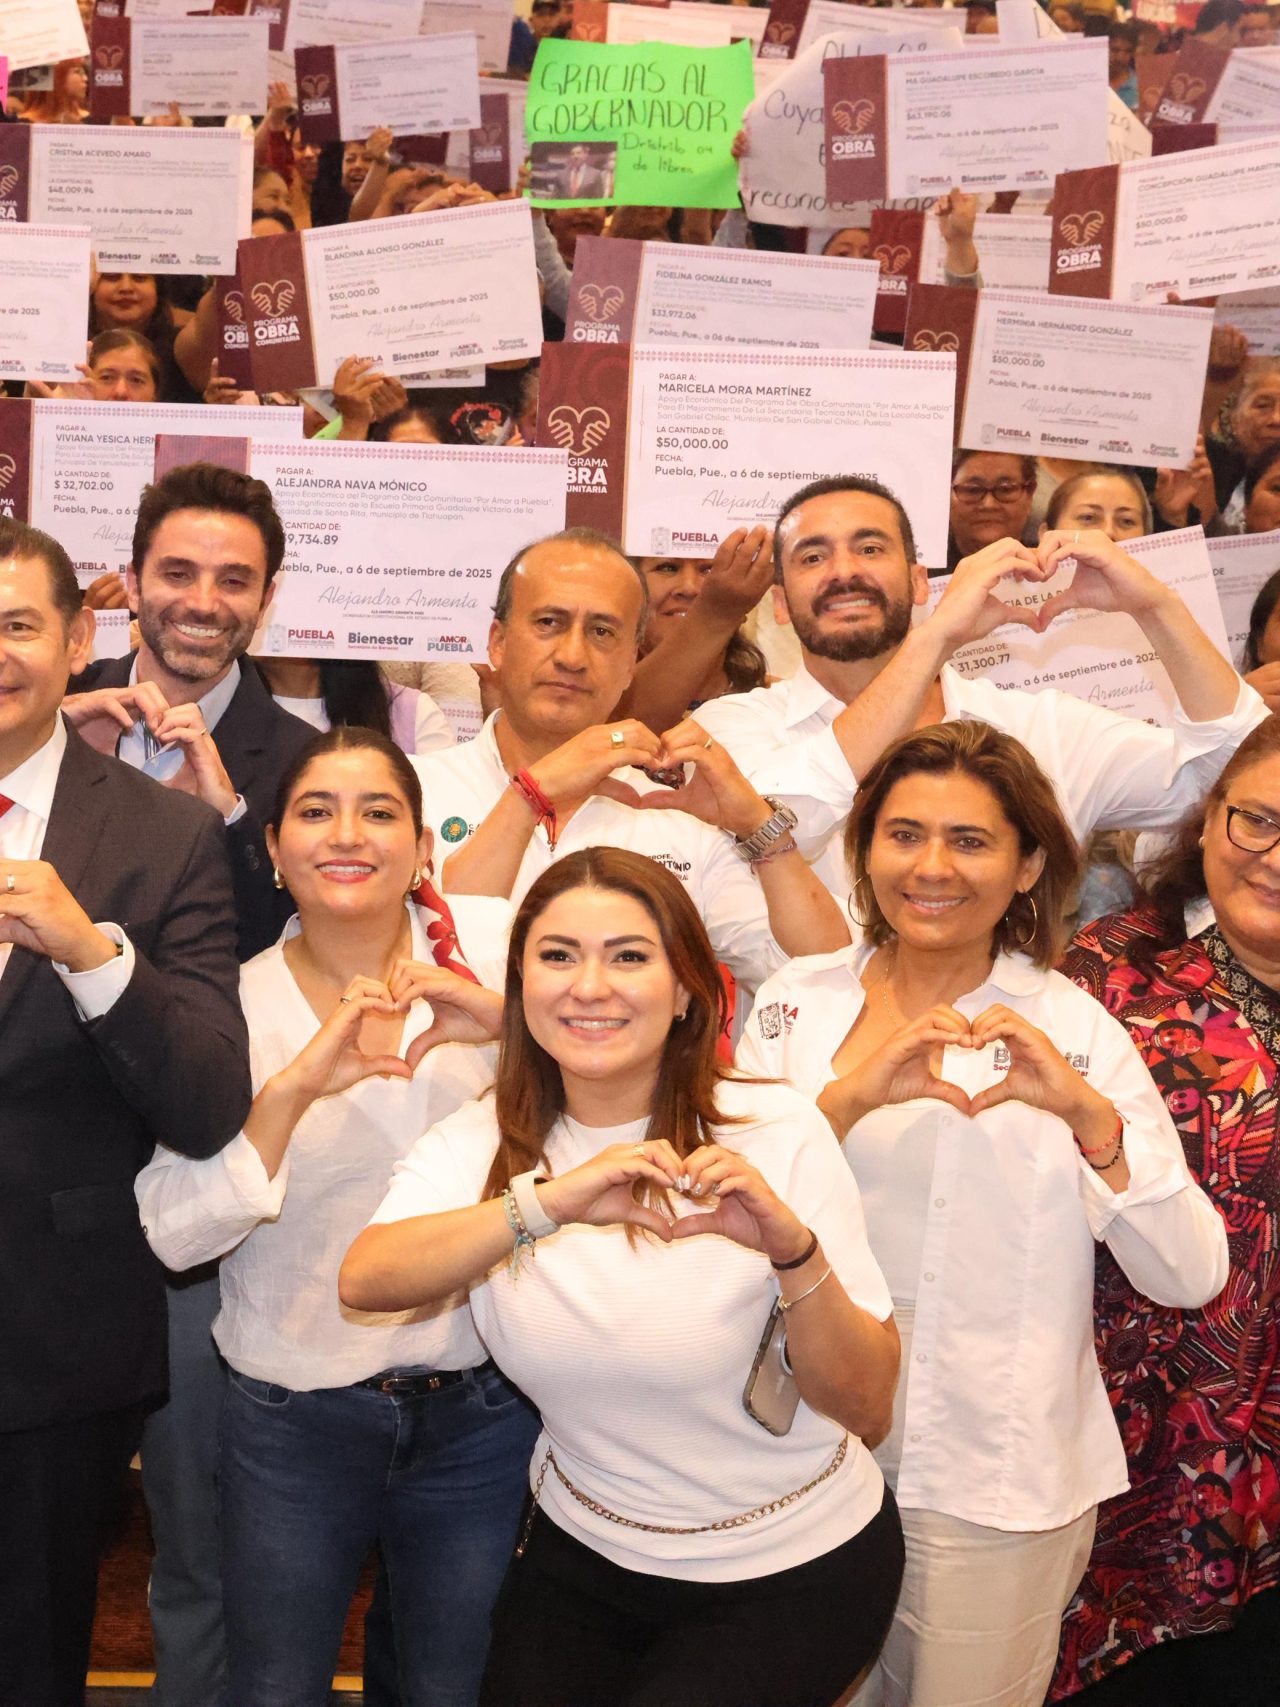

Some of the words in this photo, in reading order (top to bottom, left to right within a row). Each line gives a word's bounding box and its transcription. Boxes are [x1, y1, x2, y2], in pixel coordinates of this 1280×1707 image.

[541, 61, 666, 96] GRACIAS
[682, 63, 716, 97] AL
[324, 250, 364, 261] BLANDINA
[366, 244, 400, 255] ALONSO
[401, 238, 444, 250] GONZÁLEZ
[656, 270, 692, 280] FIDELINA
[694, 273, 739, 284] GONZÁLEZ
[741, 278, 771, 287] RAMOS
[328, 286, 379, 301] $50,000.00
[652, 308, 696, 319] $33,972.06
[253, 315, 298, 327] PROGRAMA
[574, 320, 620, 332] PROGRAMA
[997, 317, 1035, 326] HERMINIA
[1038, 321, 1087, 332] HERNÁNDEZ
[1089, 326, 1133, 336] GONZÁLEZ
[254, 323, 299, 339] OBRA
[573, 329, 619, 343] OBRA
[392, 350, 439, 361] Bienestar
[992, 355, 1045, 367] $50,000.00
[659, 383, 715, 393] MARICELA
[718, 385, 752, 394] MORA
[756, 385, 811, 396] MARTÍNEZ
[56, 434, 93, 442] VIVIANA
[96, 435, 130, 443] YESICA
[996, 428, 1030, 437] PUEBLA
[1040, 433, 1089, 445] Bienestar
[656, 436, 728, 449] $50,000.00
[568, 458, 608, 467] GRAMA
[566, 466, 608, 485] BRA
[54, 480, 60, 489] $
[63, 480, 113, 490] 32,702.00
[275, 478, 341, 488] ALEJANDRA
[344, 480, 376, 489] NAVA
[379, 481, 427, 491] MÓNICO
[566, 485, 608, 494] UNITARIA
[672, 532, 718, 542] PUEBLA
[316, 563, 342, 574] Pue.,
[356, 565, 362, 574] 6
[366, 565, 380, 574] de
[383, 566, 445, 577] septiembre
[448, 568, 462, 577] de
[465, 568, 492, 578] 2025
[318, 585, 400, 610] Alejandro
[405, 589, 478, 609] Armenta
[288, 629, 334, 639] PUEBLA
[348, 632, 413, 645] Bienestar
[427, 643, 473, 652] PUEBLA
[955, 645, 995, 658] CANTIDAD
[957, 653, 1010, 672] 31,300.77
[662, 861, 692, 872] TONIO
